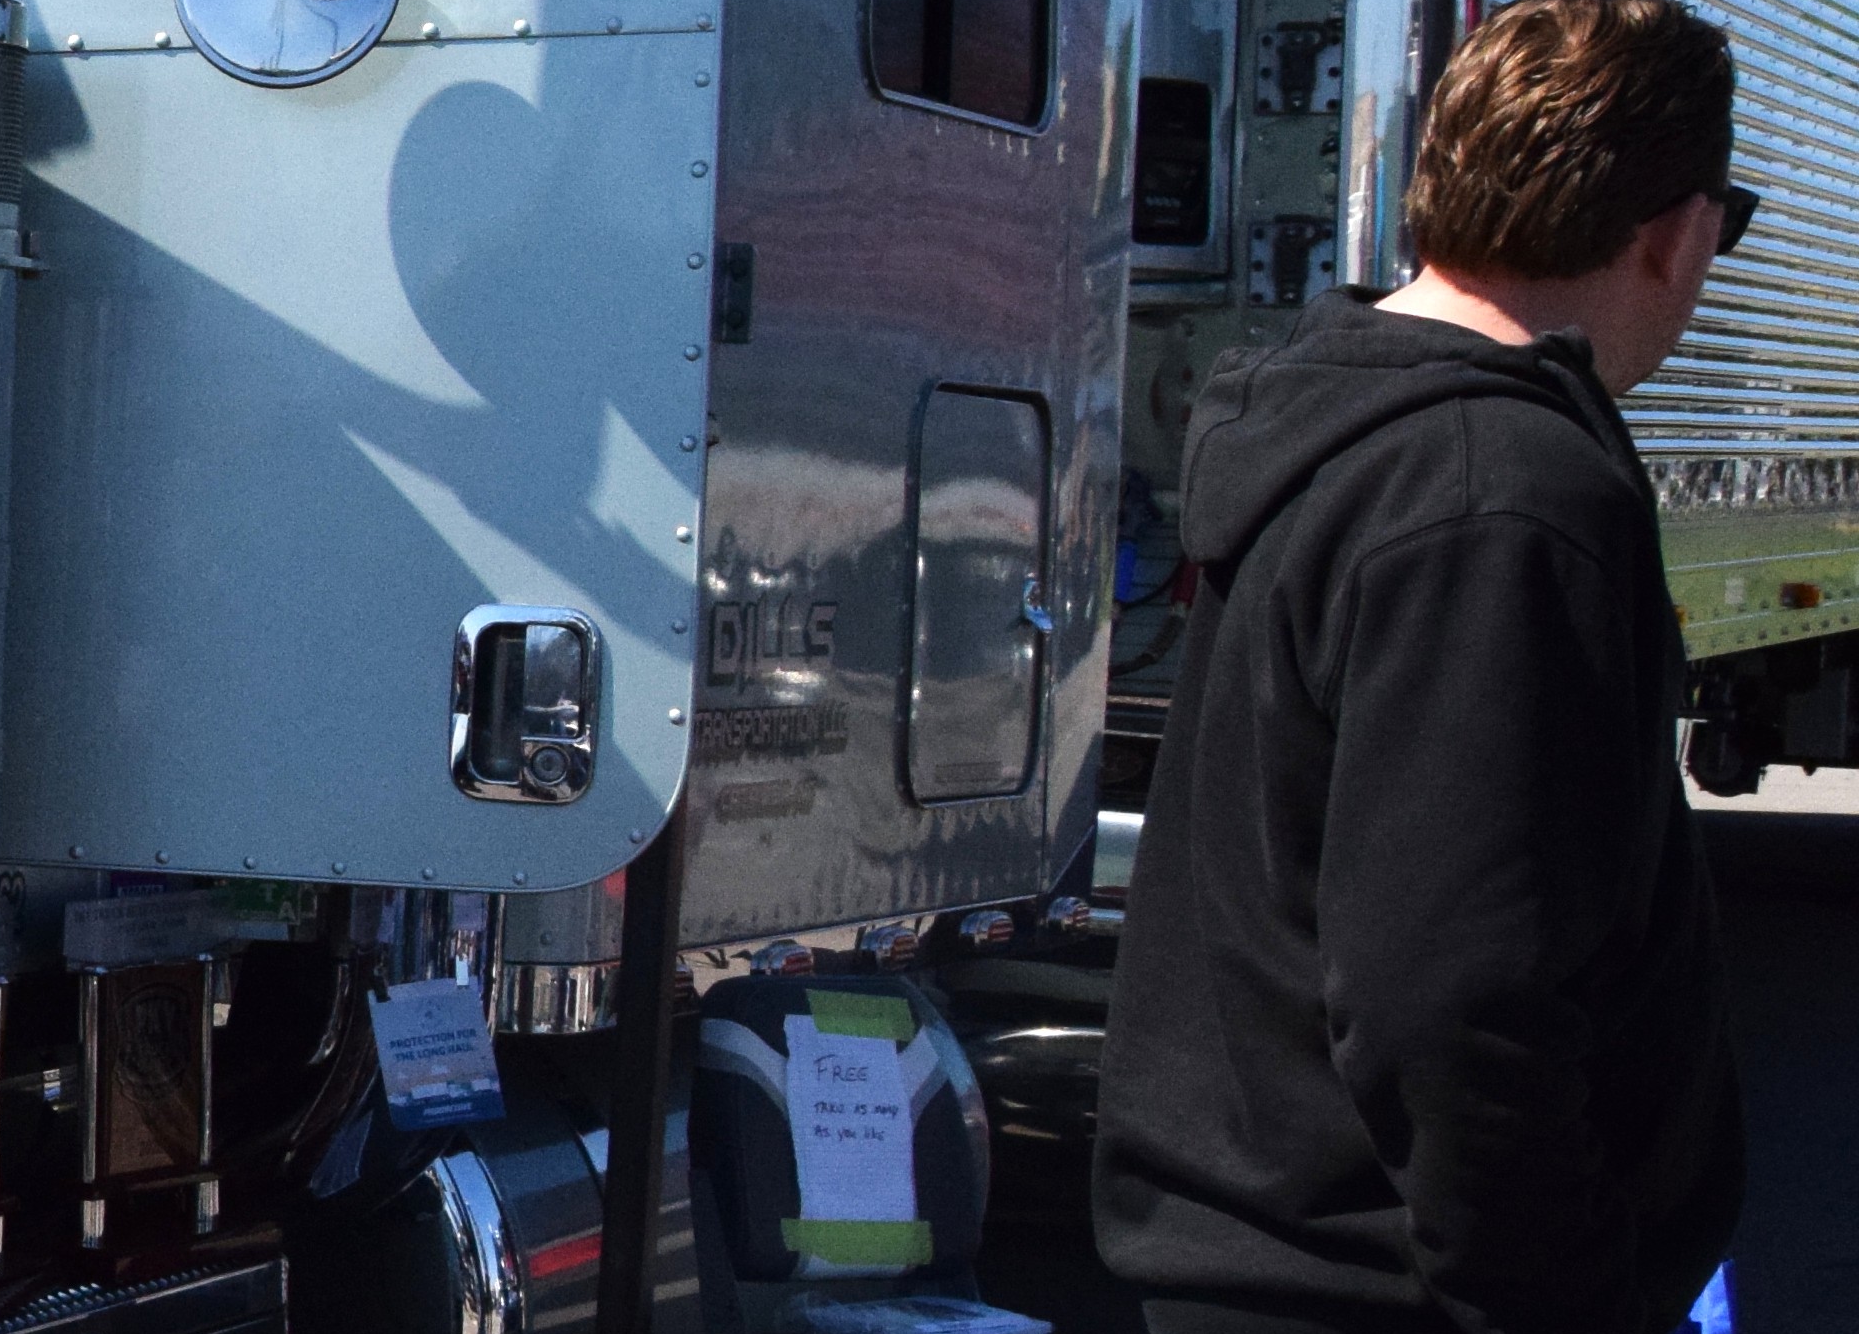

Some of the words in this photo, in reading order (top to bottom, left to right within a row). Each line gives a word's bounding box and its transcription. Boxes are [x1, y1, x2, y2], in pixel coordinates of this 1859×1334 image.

[389, 1032, 455, 1049] PROTECTION
[456, 1028, 477, 1040] FOR
[395, 1051, 415, 1061] THE
[417, 1046, 446, 1060] LONG
[448, 1043, 476, 1054] HAUL
[814, 1054, 869, 1083] FREE
